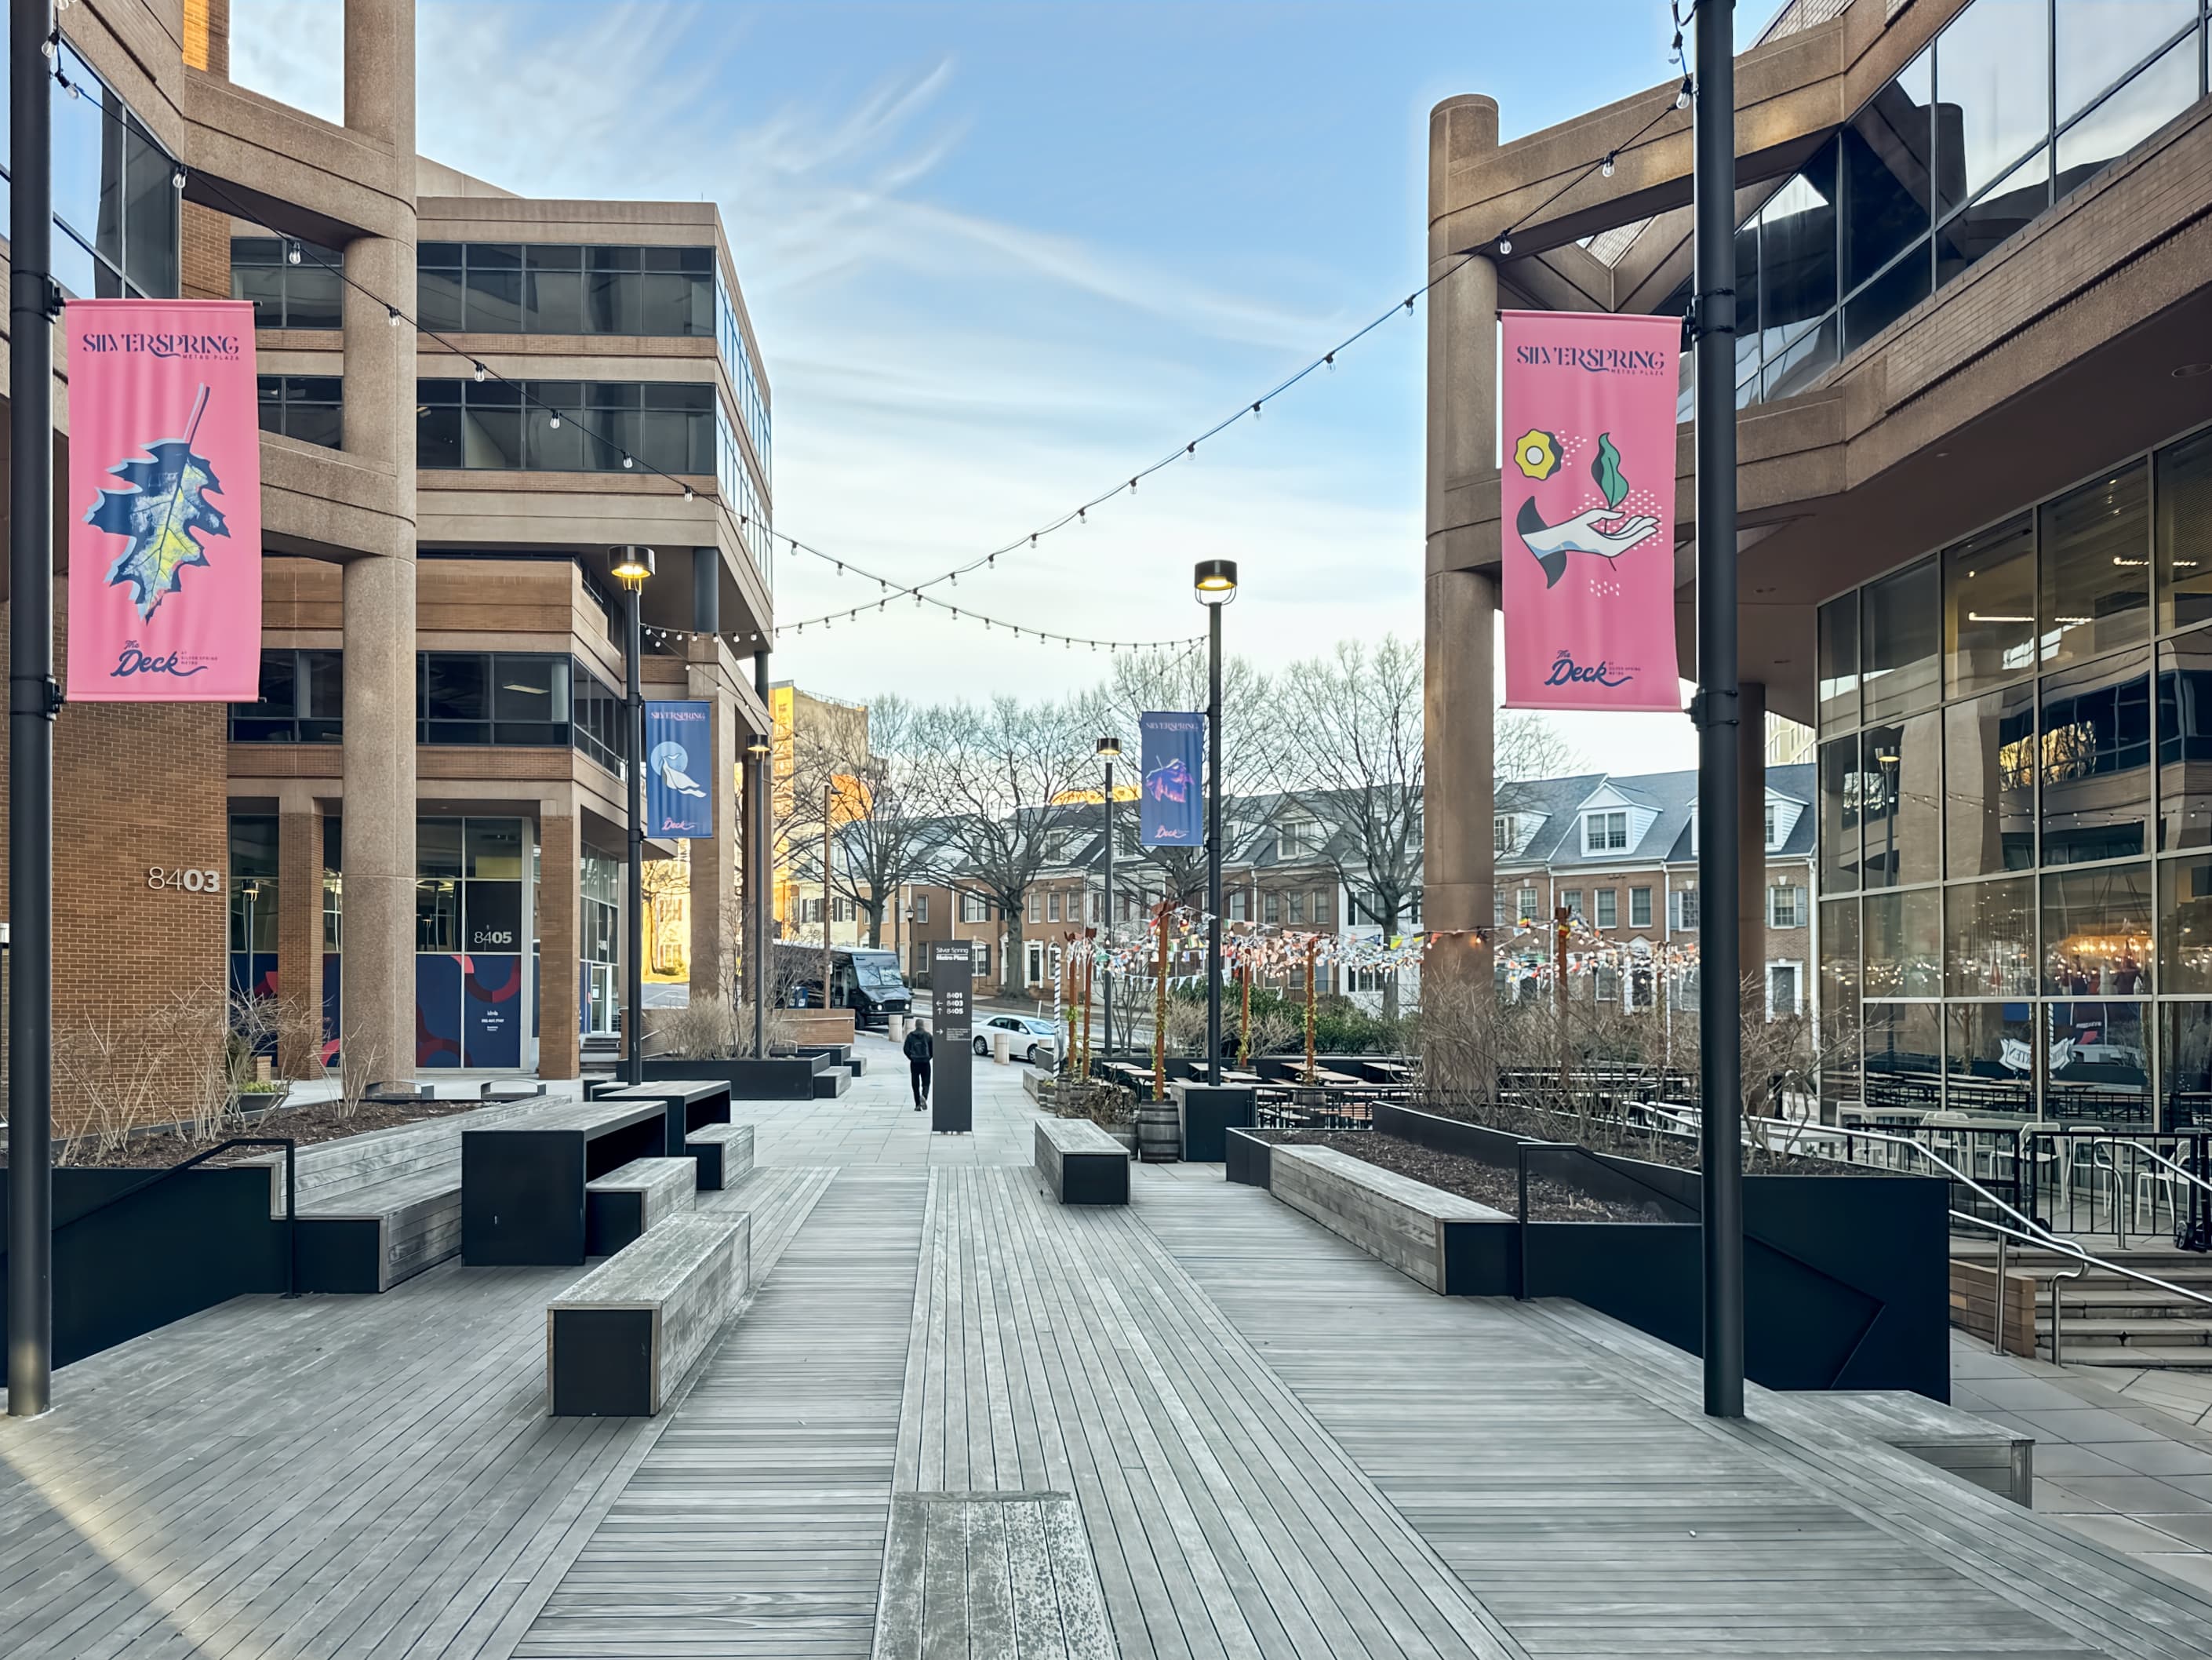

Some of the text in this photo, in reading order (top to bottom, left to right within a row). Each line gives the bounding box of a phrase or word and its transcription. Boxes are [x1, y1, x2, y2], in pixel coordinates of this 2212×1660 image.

[124, 640, 140, 650] The
[110, 649, 208, 677] Deck
[1544, 659, 1633, 687] Deck
[661, 820, 695, 831] Deck
[1154, 828, 1187, 839] Deck
[147, 866, 220, 893] 8403
[474, 931, 512, 945] 8405
